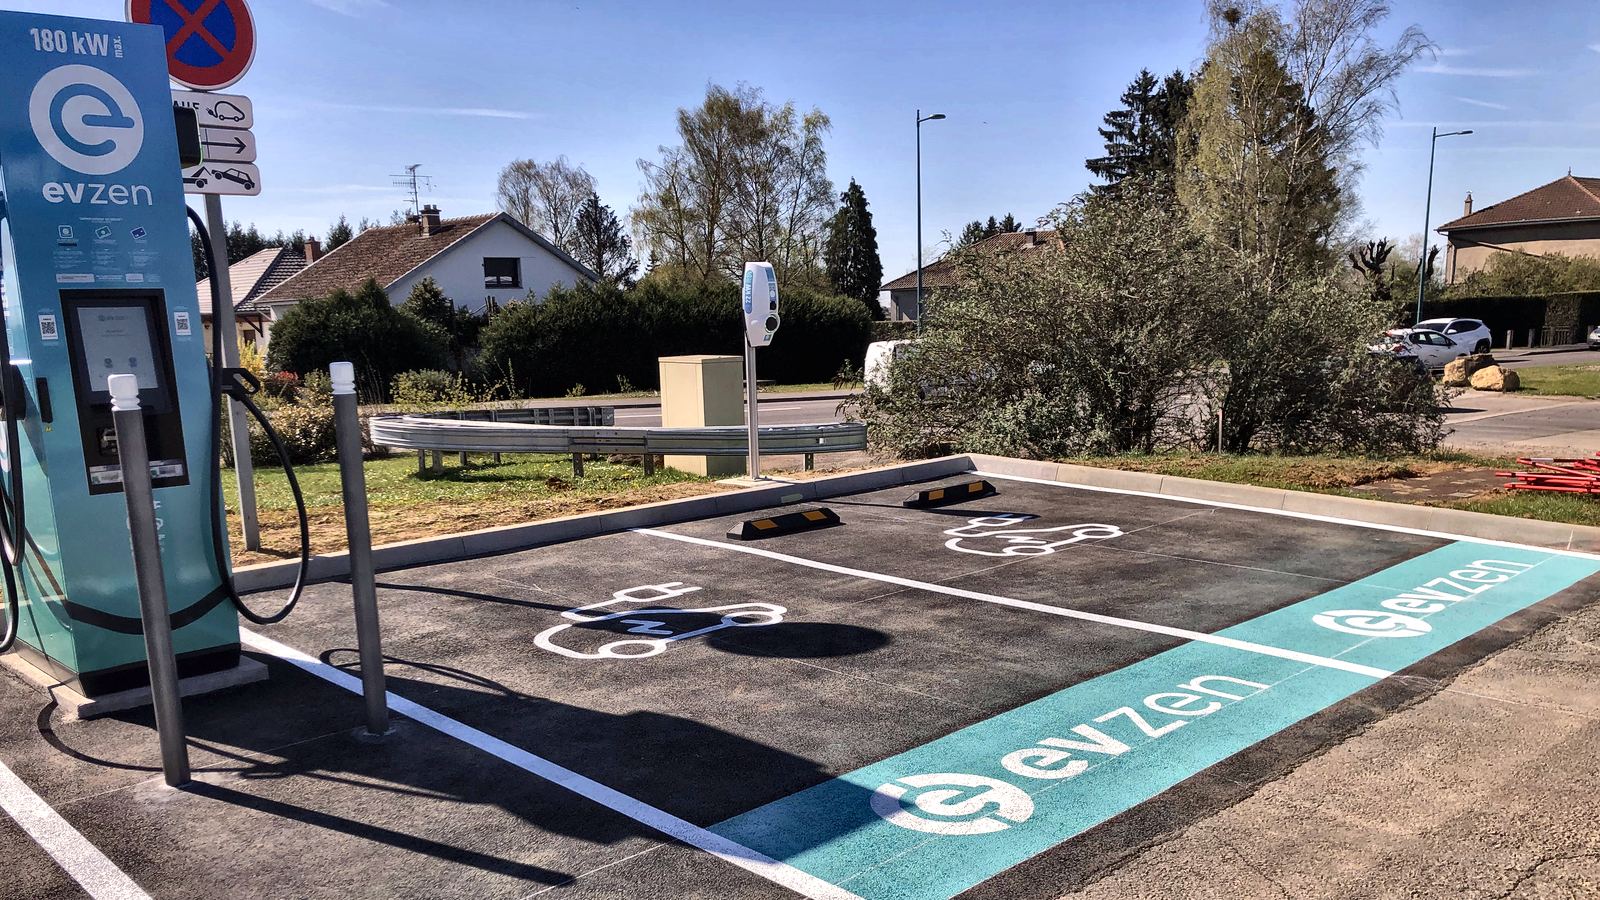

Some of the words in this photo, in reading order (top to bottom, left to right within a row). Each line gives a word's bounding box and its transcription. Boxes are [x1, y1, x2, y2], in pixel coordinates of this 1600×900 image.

[30, 27, 68, 53] 180
[71, 31, 109, 57] kW
[113, 35, 123, 58] max.
[42, 181, 153, 206] evzen
[1380, 559, 1534, 613] evzen
[1001, 674, 1271, 779] evzen
